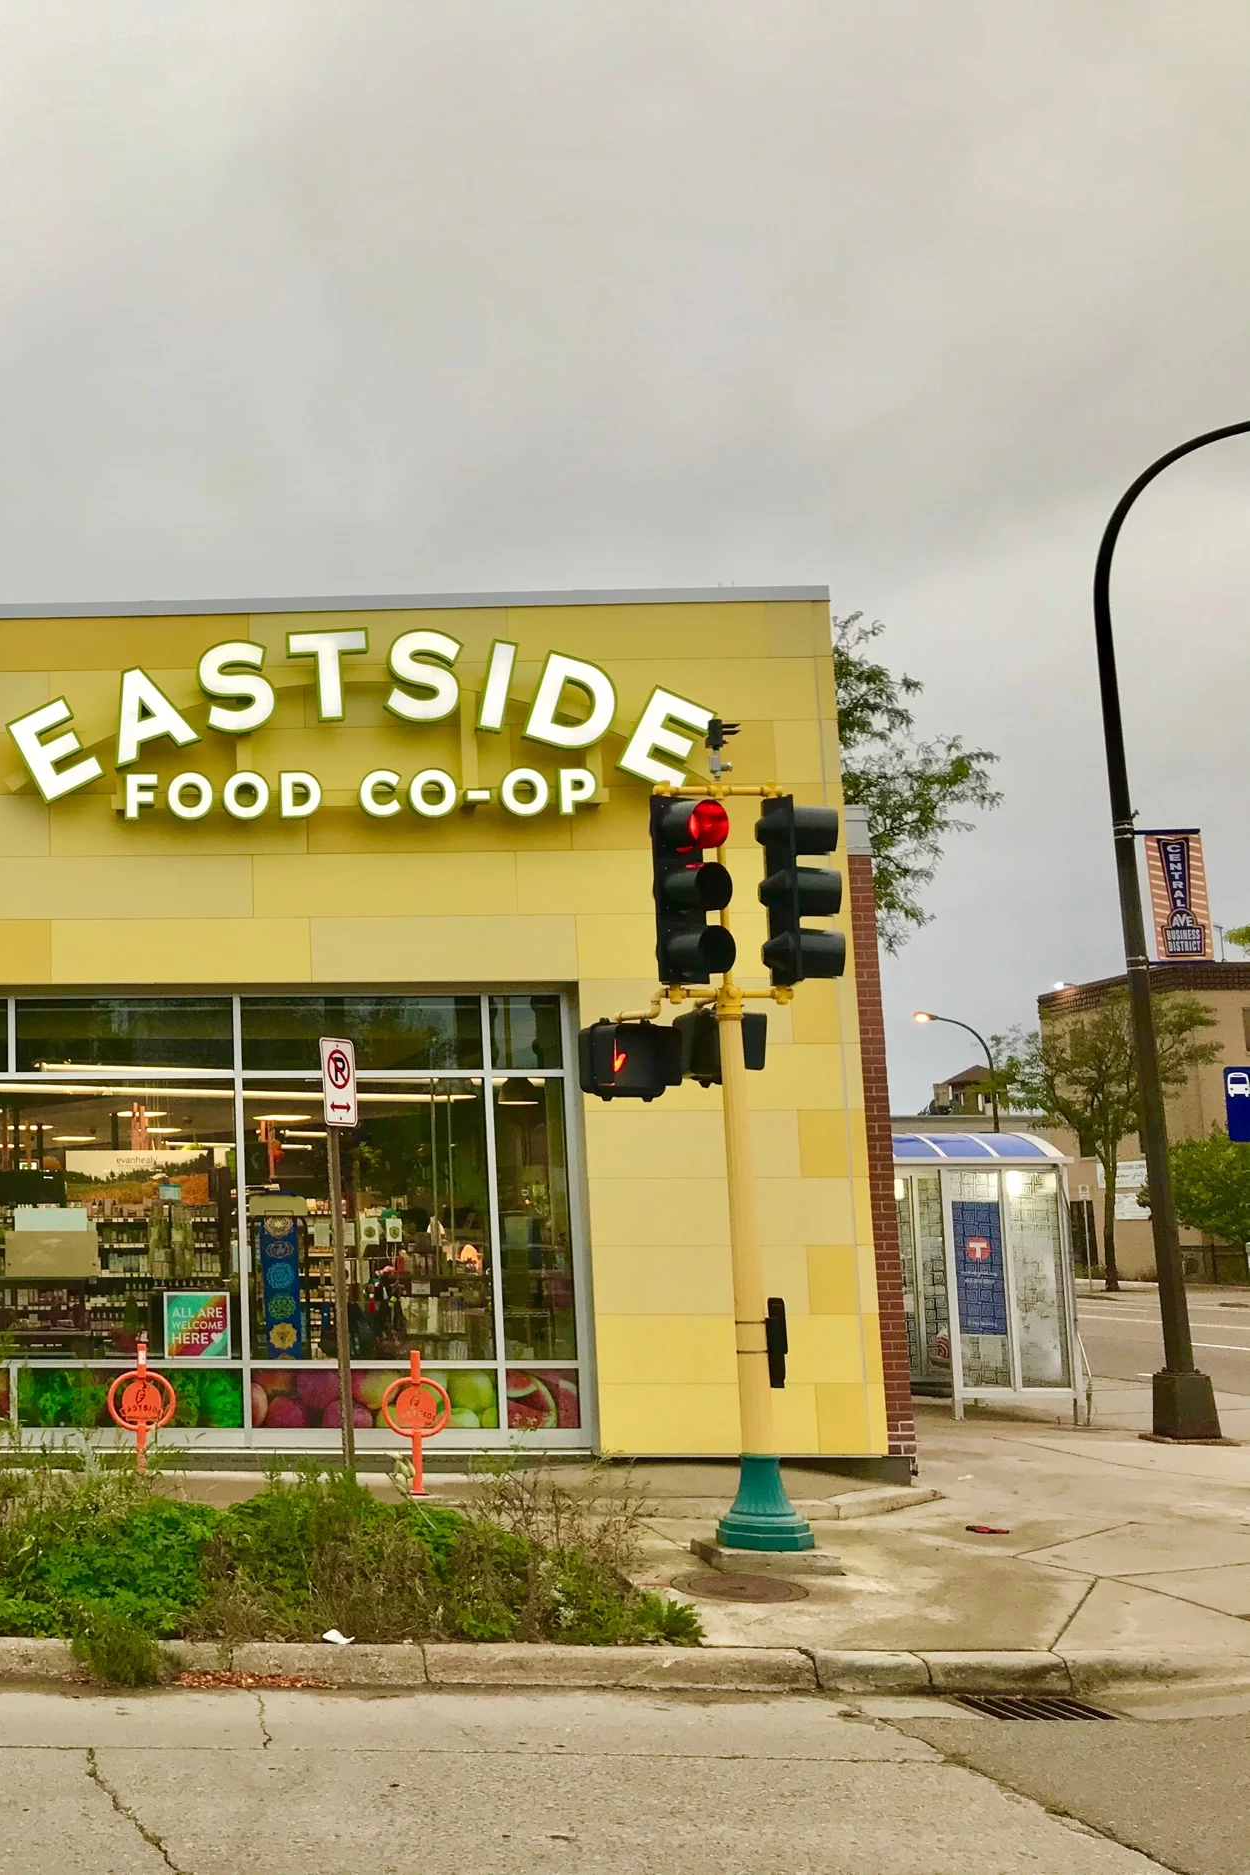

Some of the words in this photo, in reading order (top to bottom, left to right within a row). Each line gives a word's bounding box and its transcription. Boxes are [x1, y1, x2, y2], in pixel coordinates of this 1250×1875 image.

[4, 626, 716, 804] EASTSIDE
[124, 768, 322, 821] FOOD
[357, 766, 598, 820] CO-OP
[1166, 844, 1185, 907] CENTRAL
[1172, 913, 1193, 927] AVE
[1166, 929, 1201, 940] BUSINESS
[1168, 941, 1201, 952] DISTRICT
[116, 1156, 157, 1165] evanhealy
[172, 1307, 194, 1318] ALL
[197, 1306, 223, 1318] ARE
[172, 1321, 223, 1330] WELCOME
[172, 1332, 209, 1344] HERE
